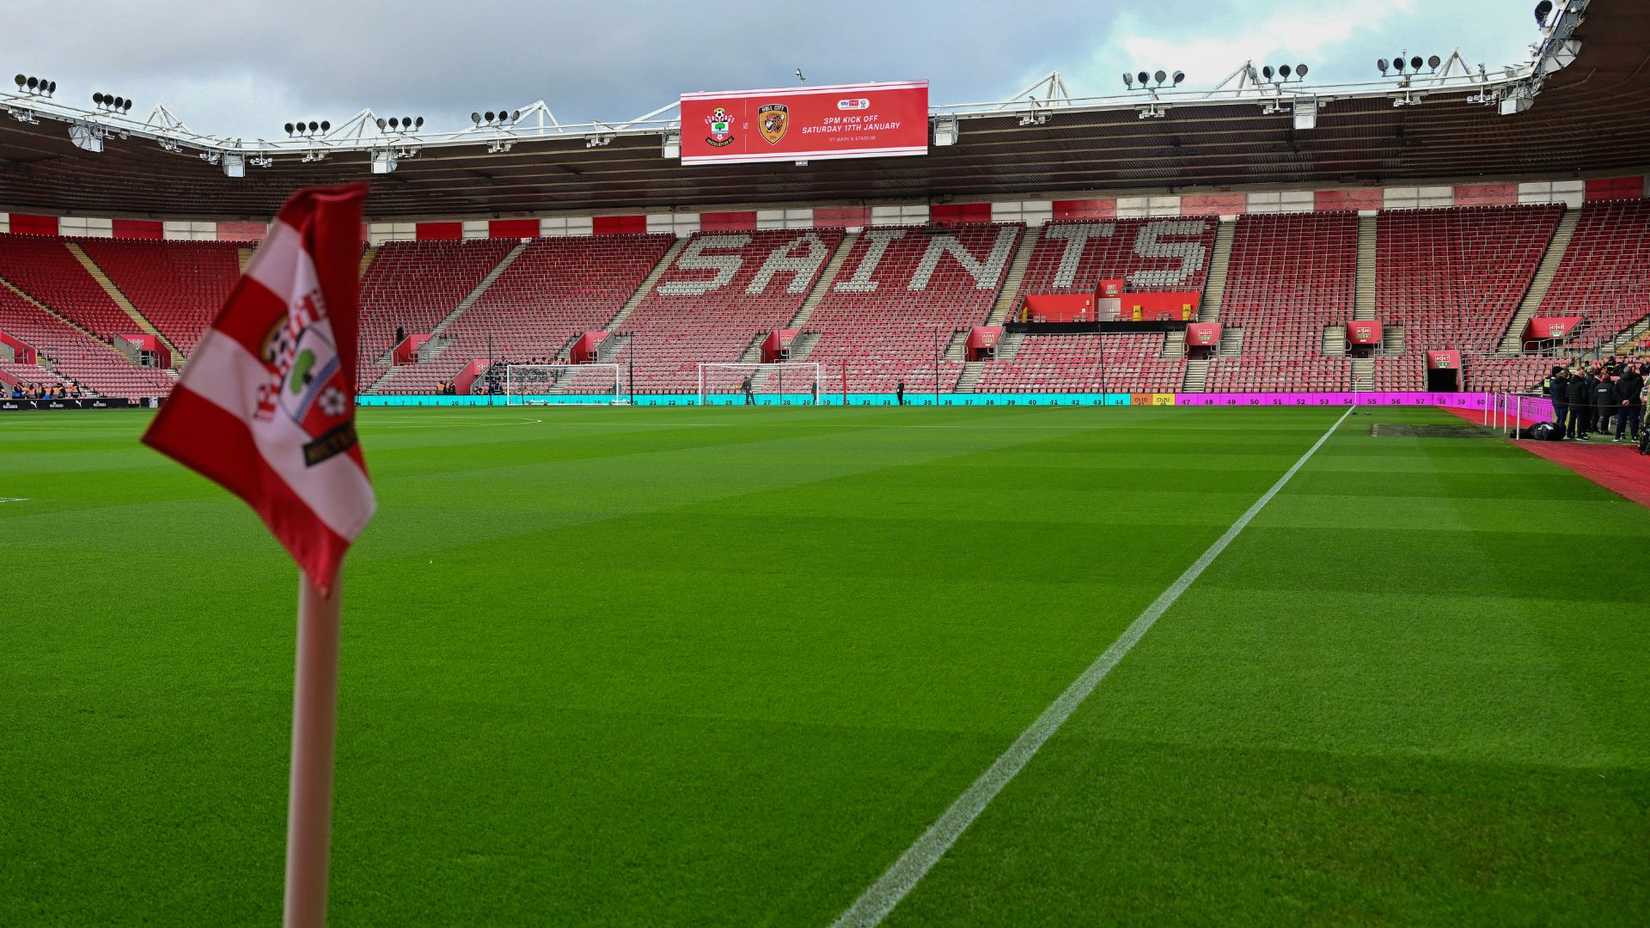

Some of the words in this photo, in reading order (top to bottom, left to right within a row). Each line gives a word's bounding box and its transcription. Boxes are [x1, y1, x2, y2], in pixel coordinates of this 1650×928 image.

[863, 114, 878, 122] OFF
[802, 124, 842, 134] SATURDAY
[863, 122, 901, 131] JANUARY
[657, 220, 1206, 296] SAINTS
